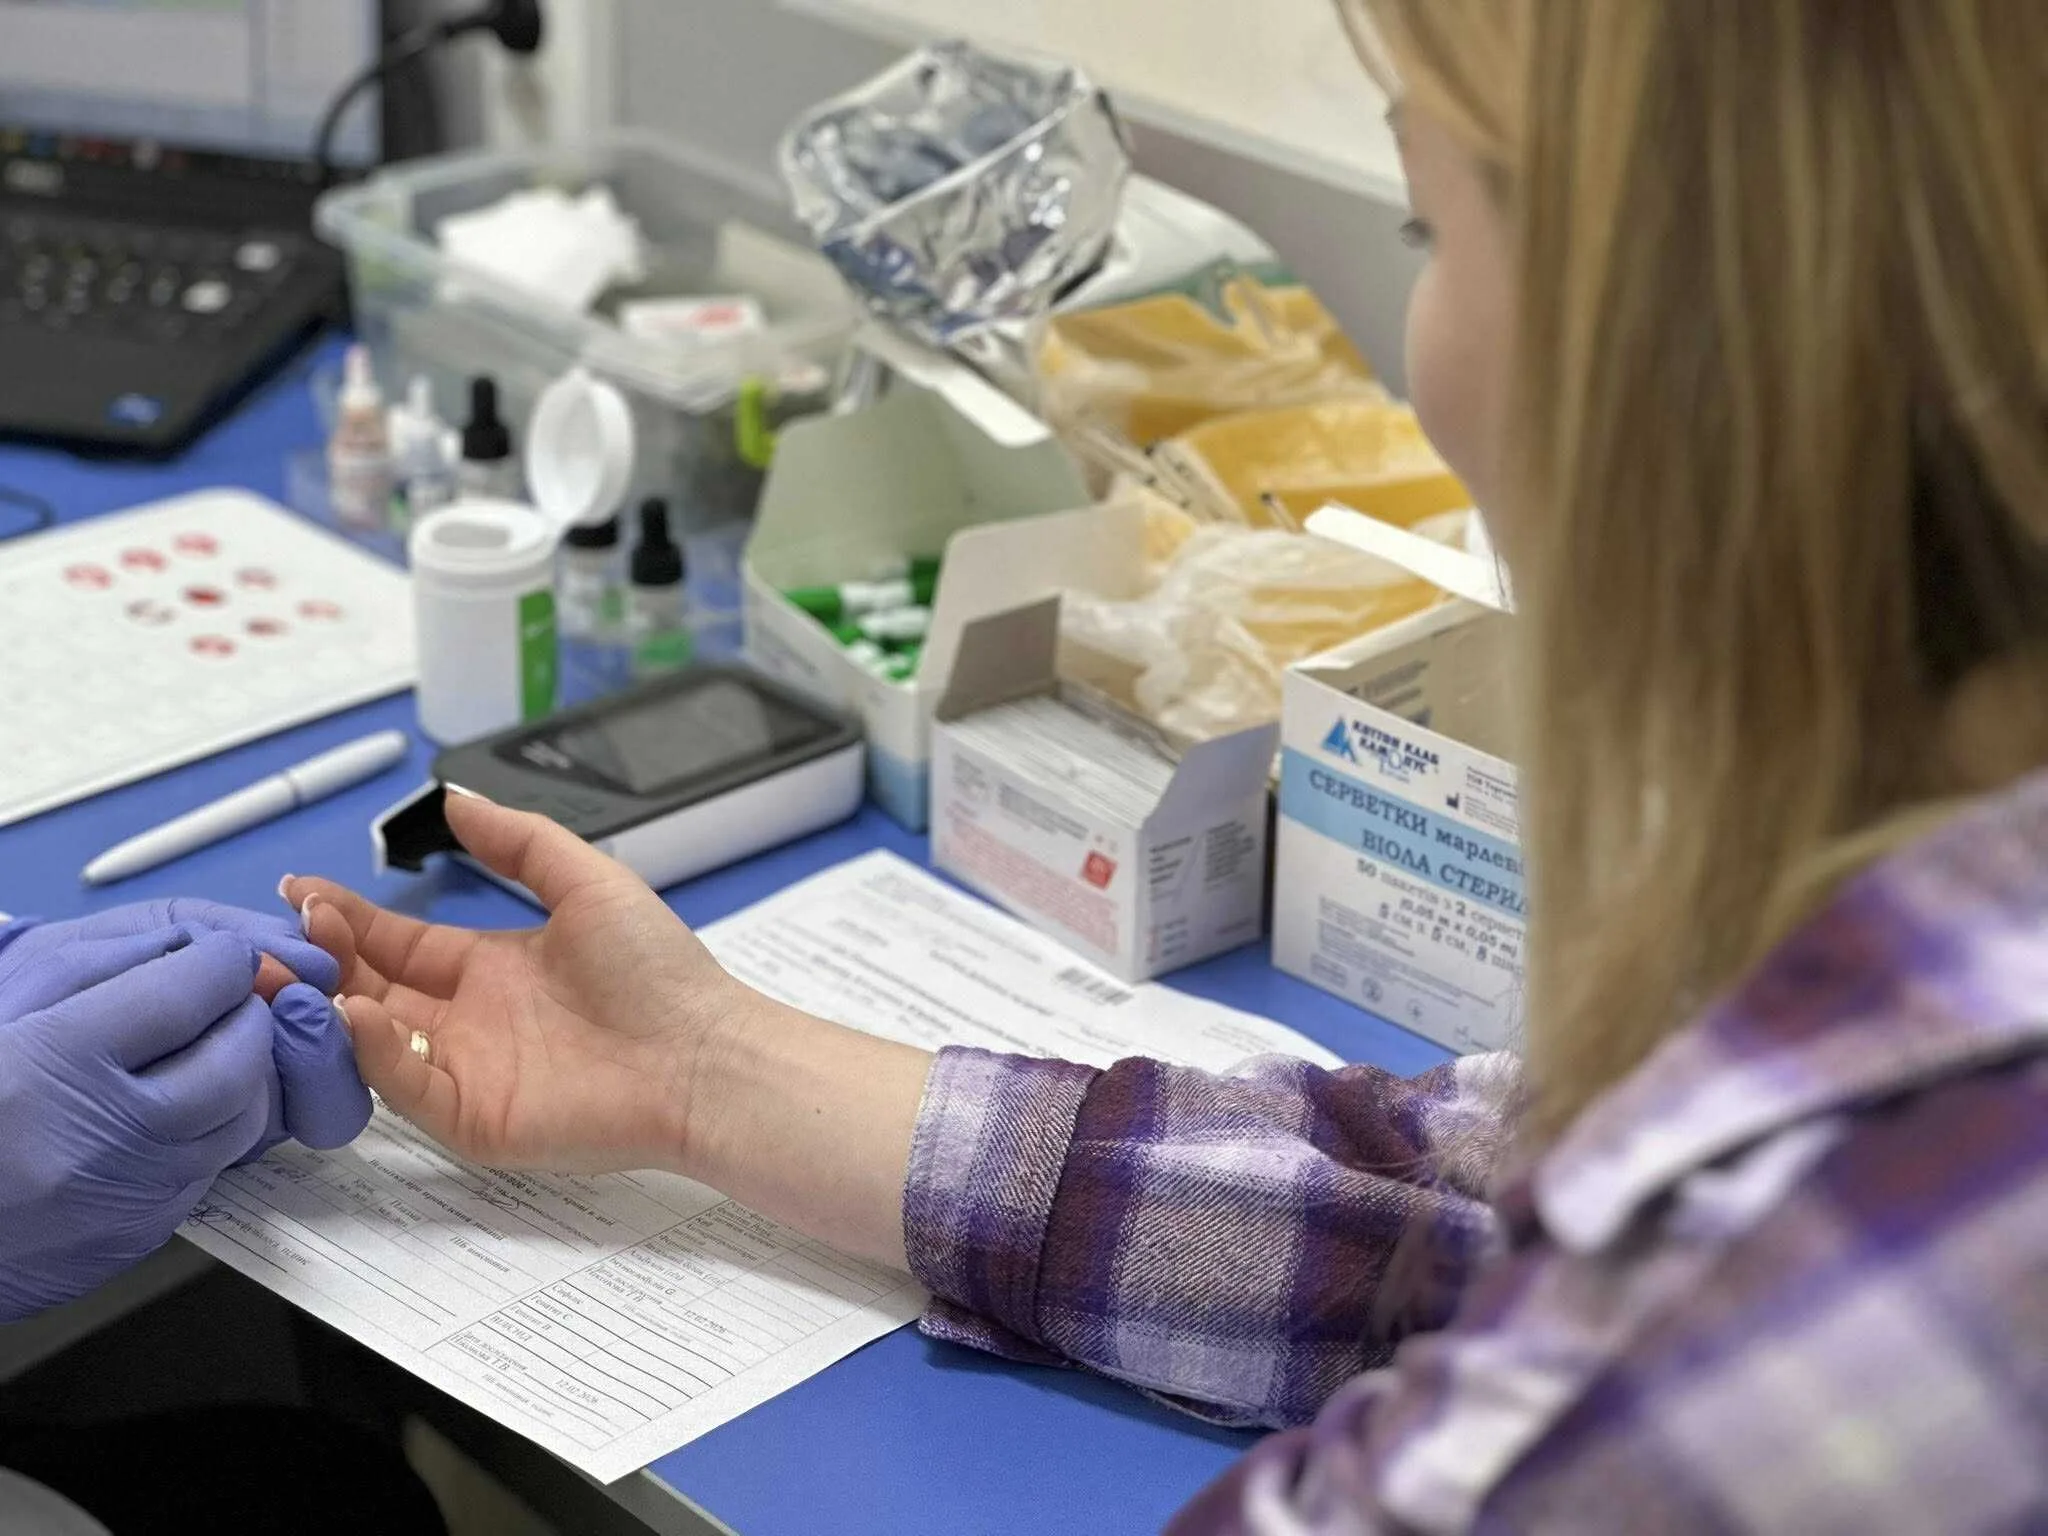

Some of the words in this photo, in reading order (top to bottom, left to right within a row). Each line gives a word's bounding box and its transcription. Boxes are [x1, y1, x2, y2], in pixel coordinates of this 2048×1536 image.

[1309, 769, 1429, 837] СЕРВЕТКИ
[1361, 828, 1432, 876] ВІОЛА
[1356, 858, 1378, 879] 50
[1455, 900, 1466, 917] 2
[450, 1235, 469, 1250] ПІБ
